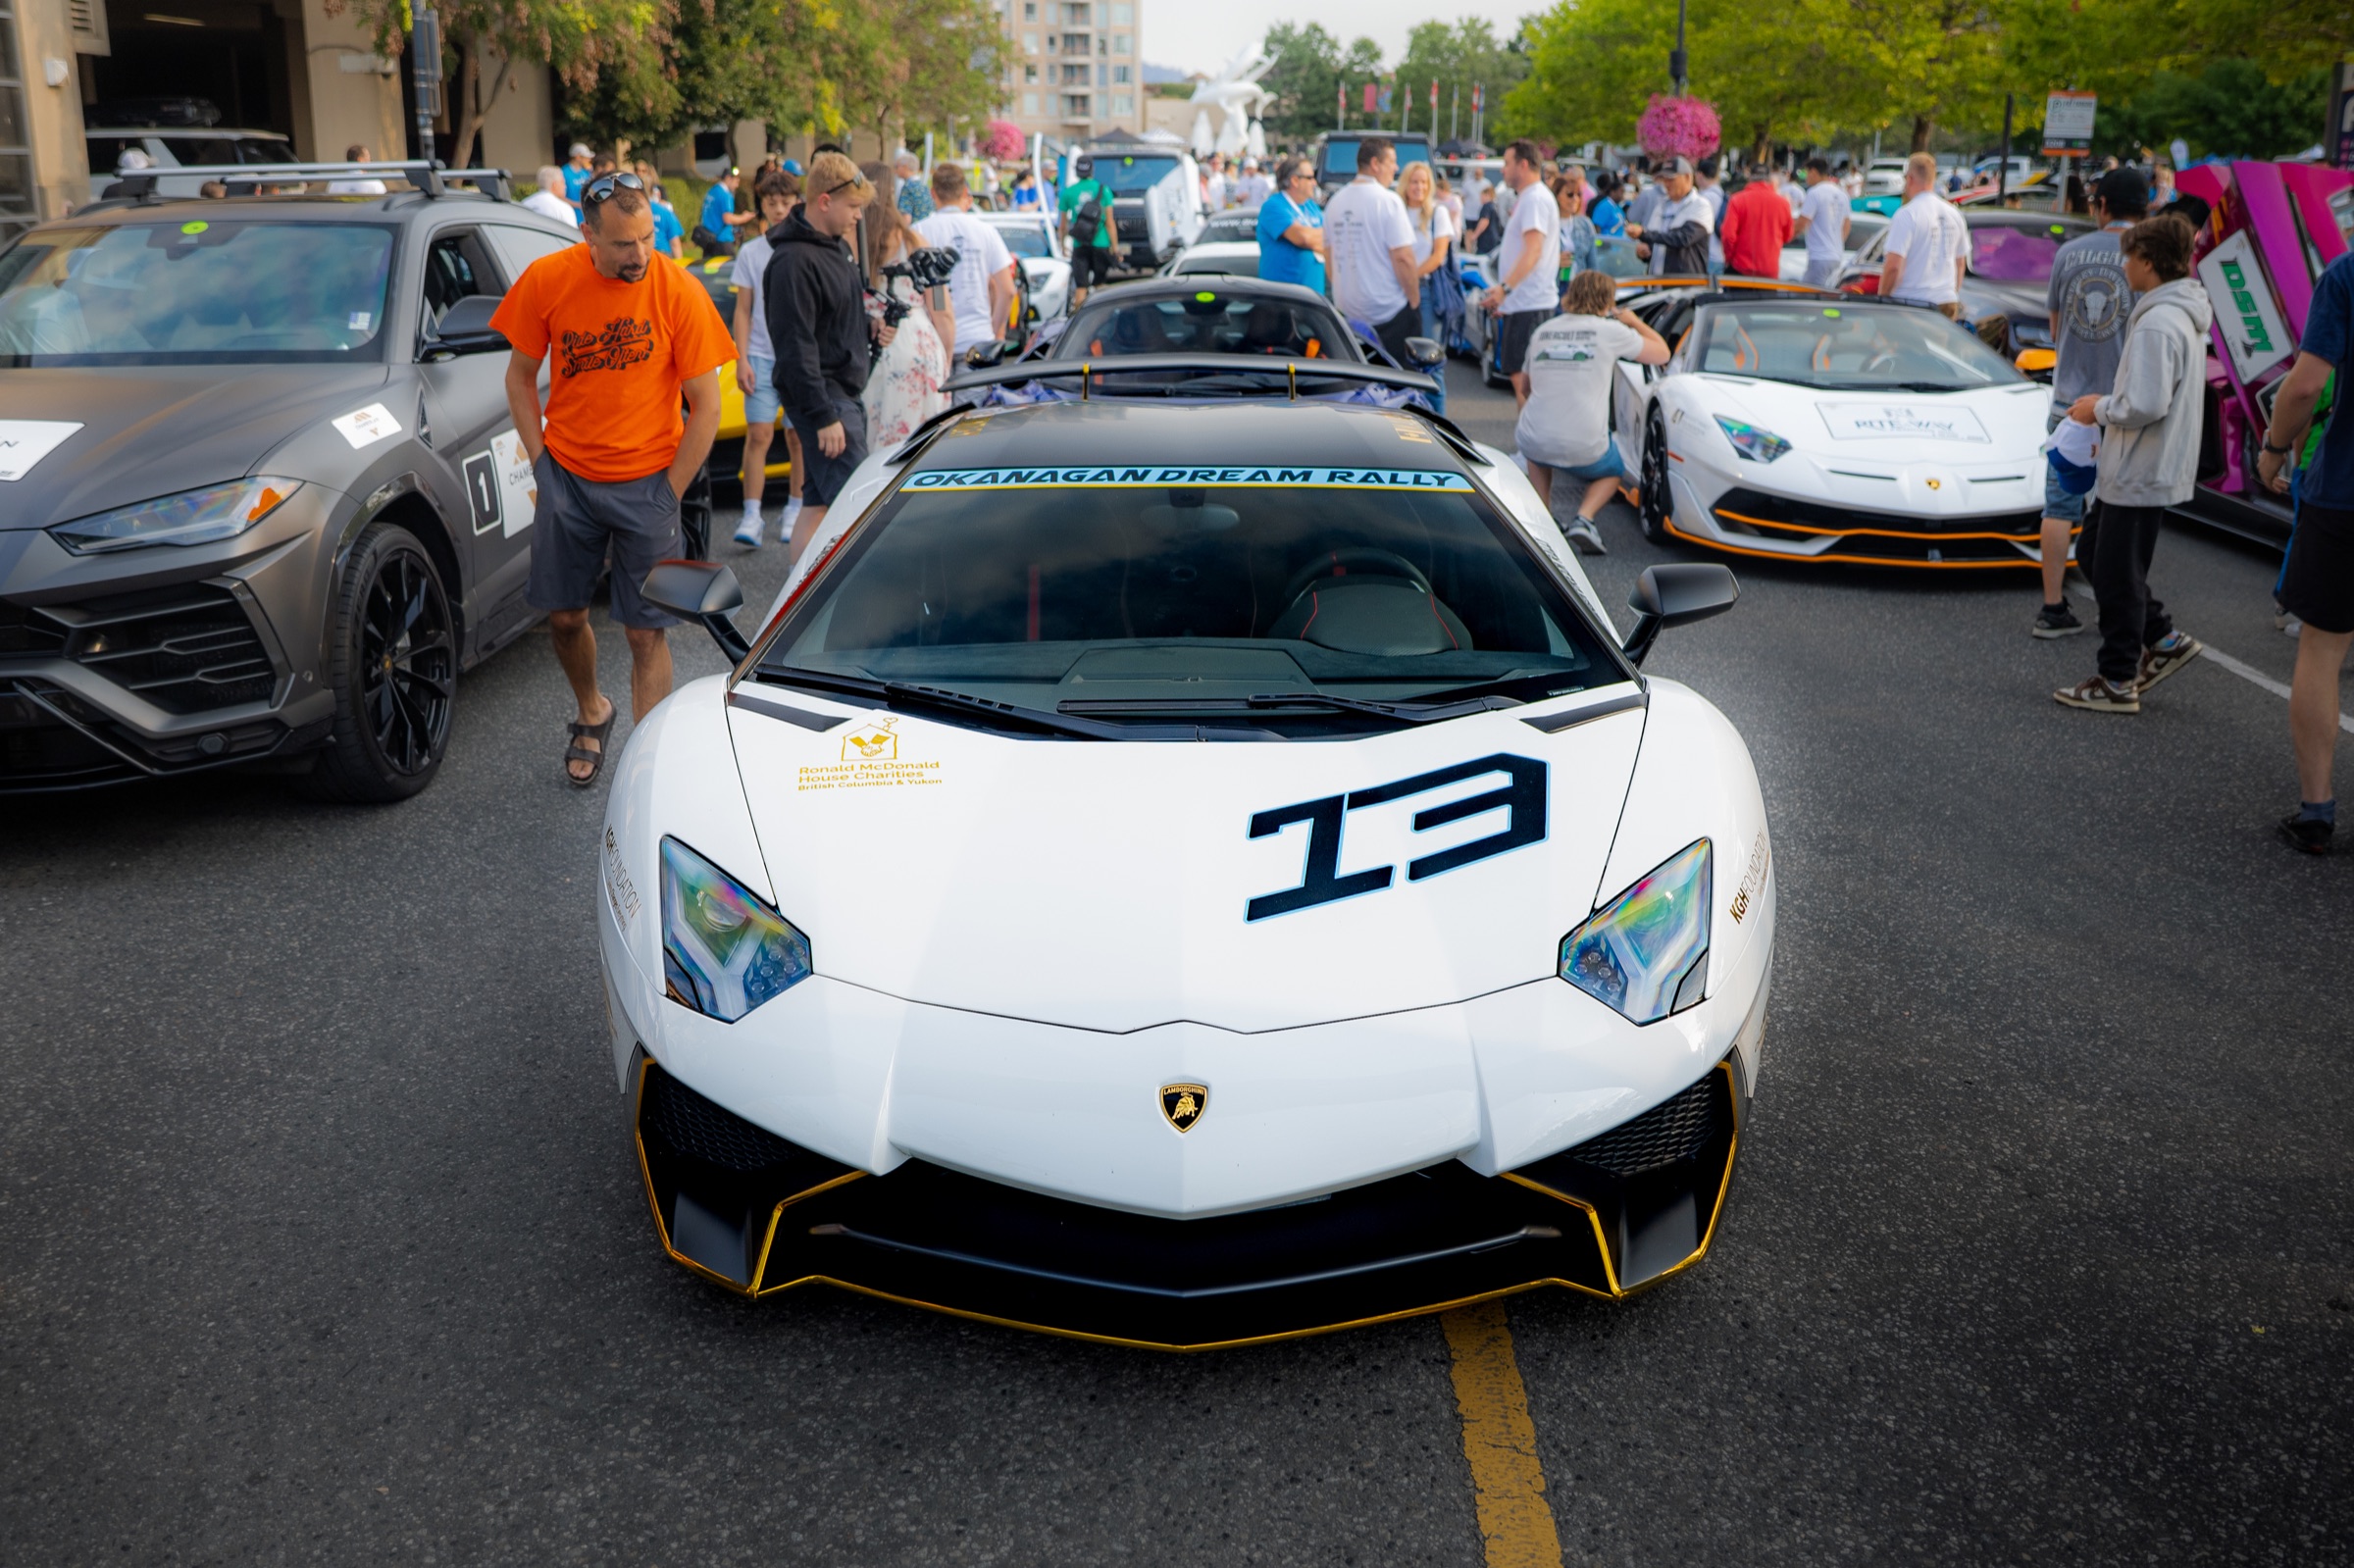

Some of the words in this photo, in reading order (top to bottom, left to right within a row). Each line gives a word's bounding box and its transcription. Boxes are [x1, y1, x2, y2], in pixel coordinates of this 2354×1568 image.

[913, 469, 1152, 486] OKANAGAN
[1155, 469, 1314, 482] DREAM
[1326, 470, 1455, 487] RALLY
[478, 472, 489, 512] 1
[799, 764, 854, 775] Ronald
[859, 761, 940, 771] McDonald
[798, 774, 849, 784] House
[853, 770, 924, 781] Charities
[838, 780, 893, 788] Columbia
[1243, 751, 1550, 924] 13
[1163, 1086, 1205, 1095] LAMBORGHINI
